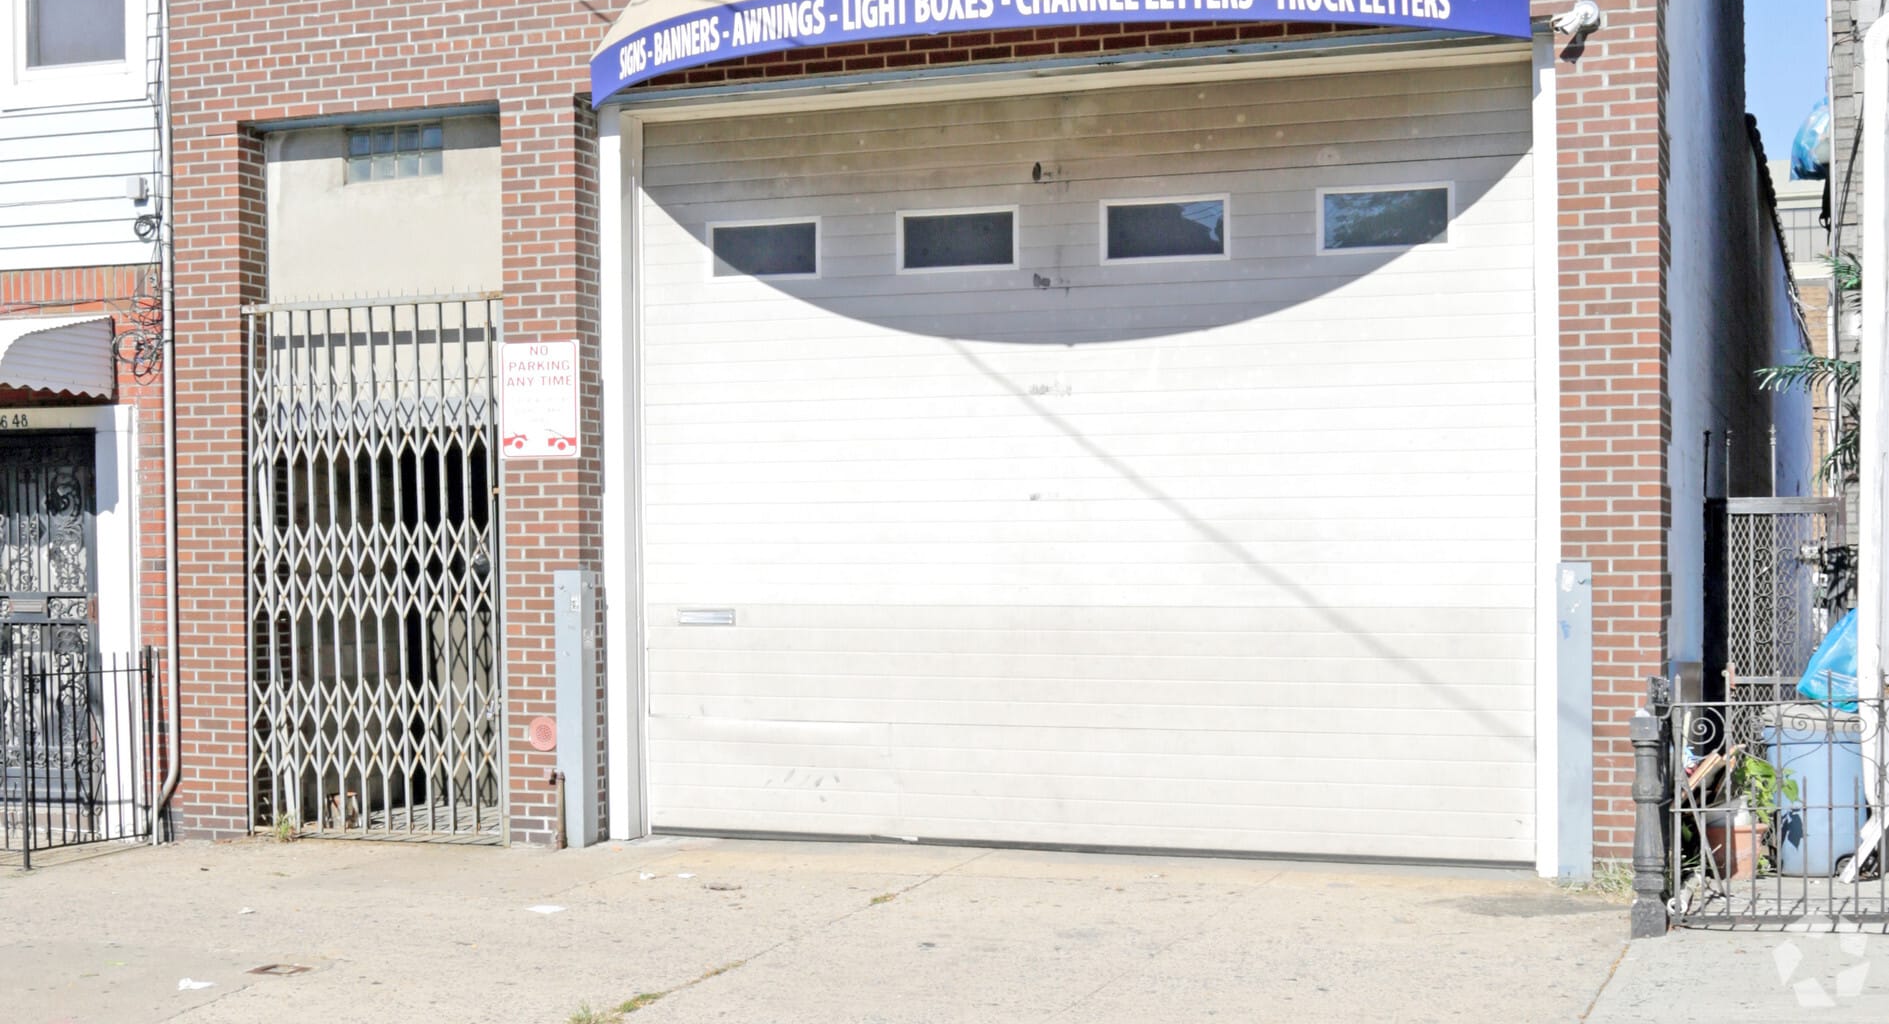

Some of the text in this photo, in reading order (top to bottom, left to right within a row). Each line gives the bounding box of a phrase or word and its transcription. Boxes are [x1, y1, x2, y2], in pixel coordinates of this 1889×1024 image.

[618, 37, 647, 80] SIGNS
[653, 16, 721, 66] BANNERS
[529, 345, 549, 356] NO
[508, 360, 571, 372] PARKING
[506, 375, 573, 387] ANY TIME
